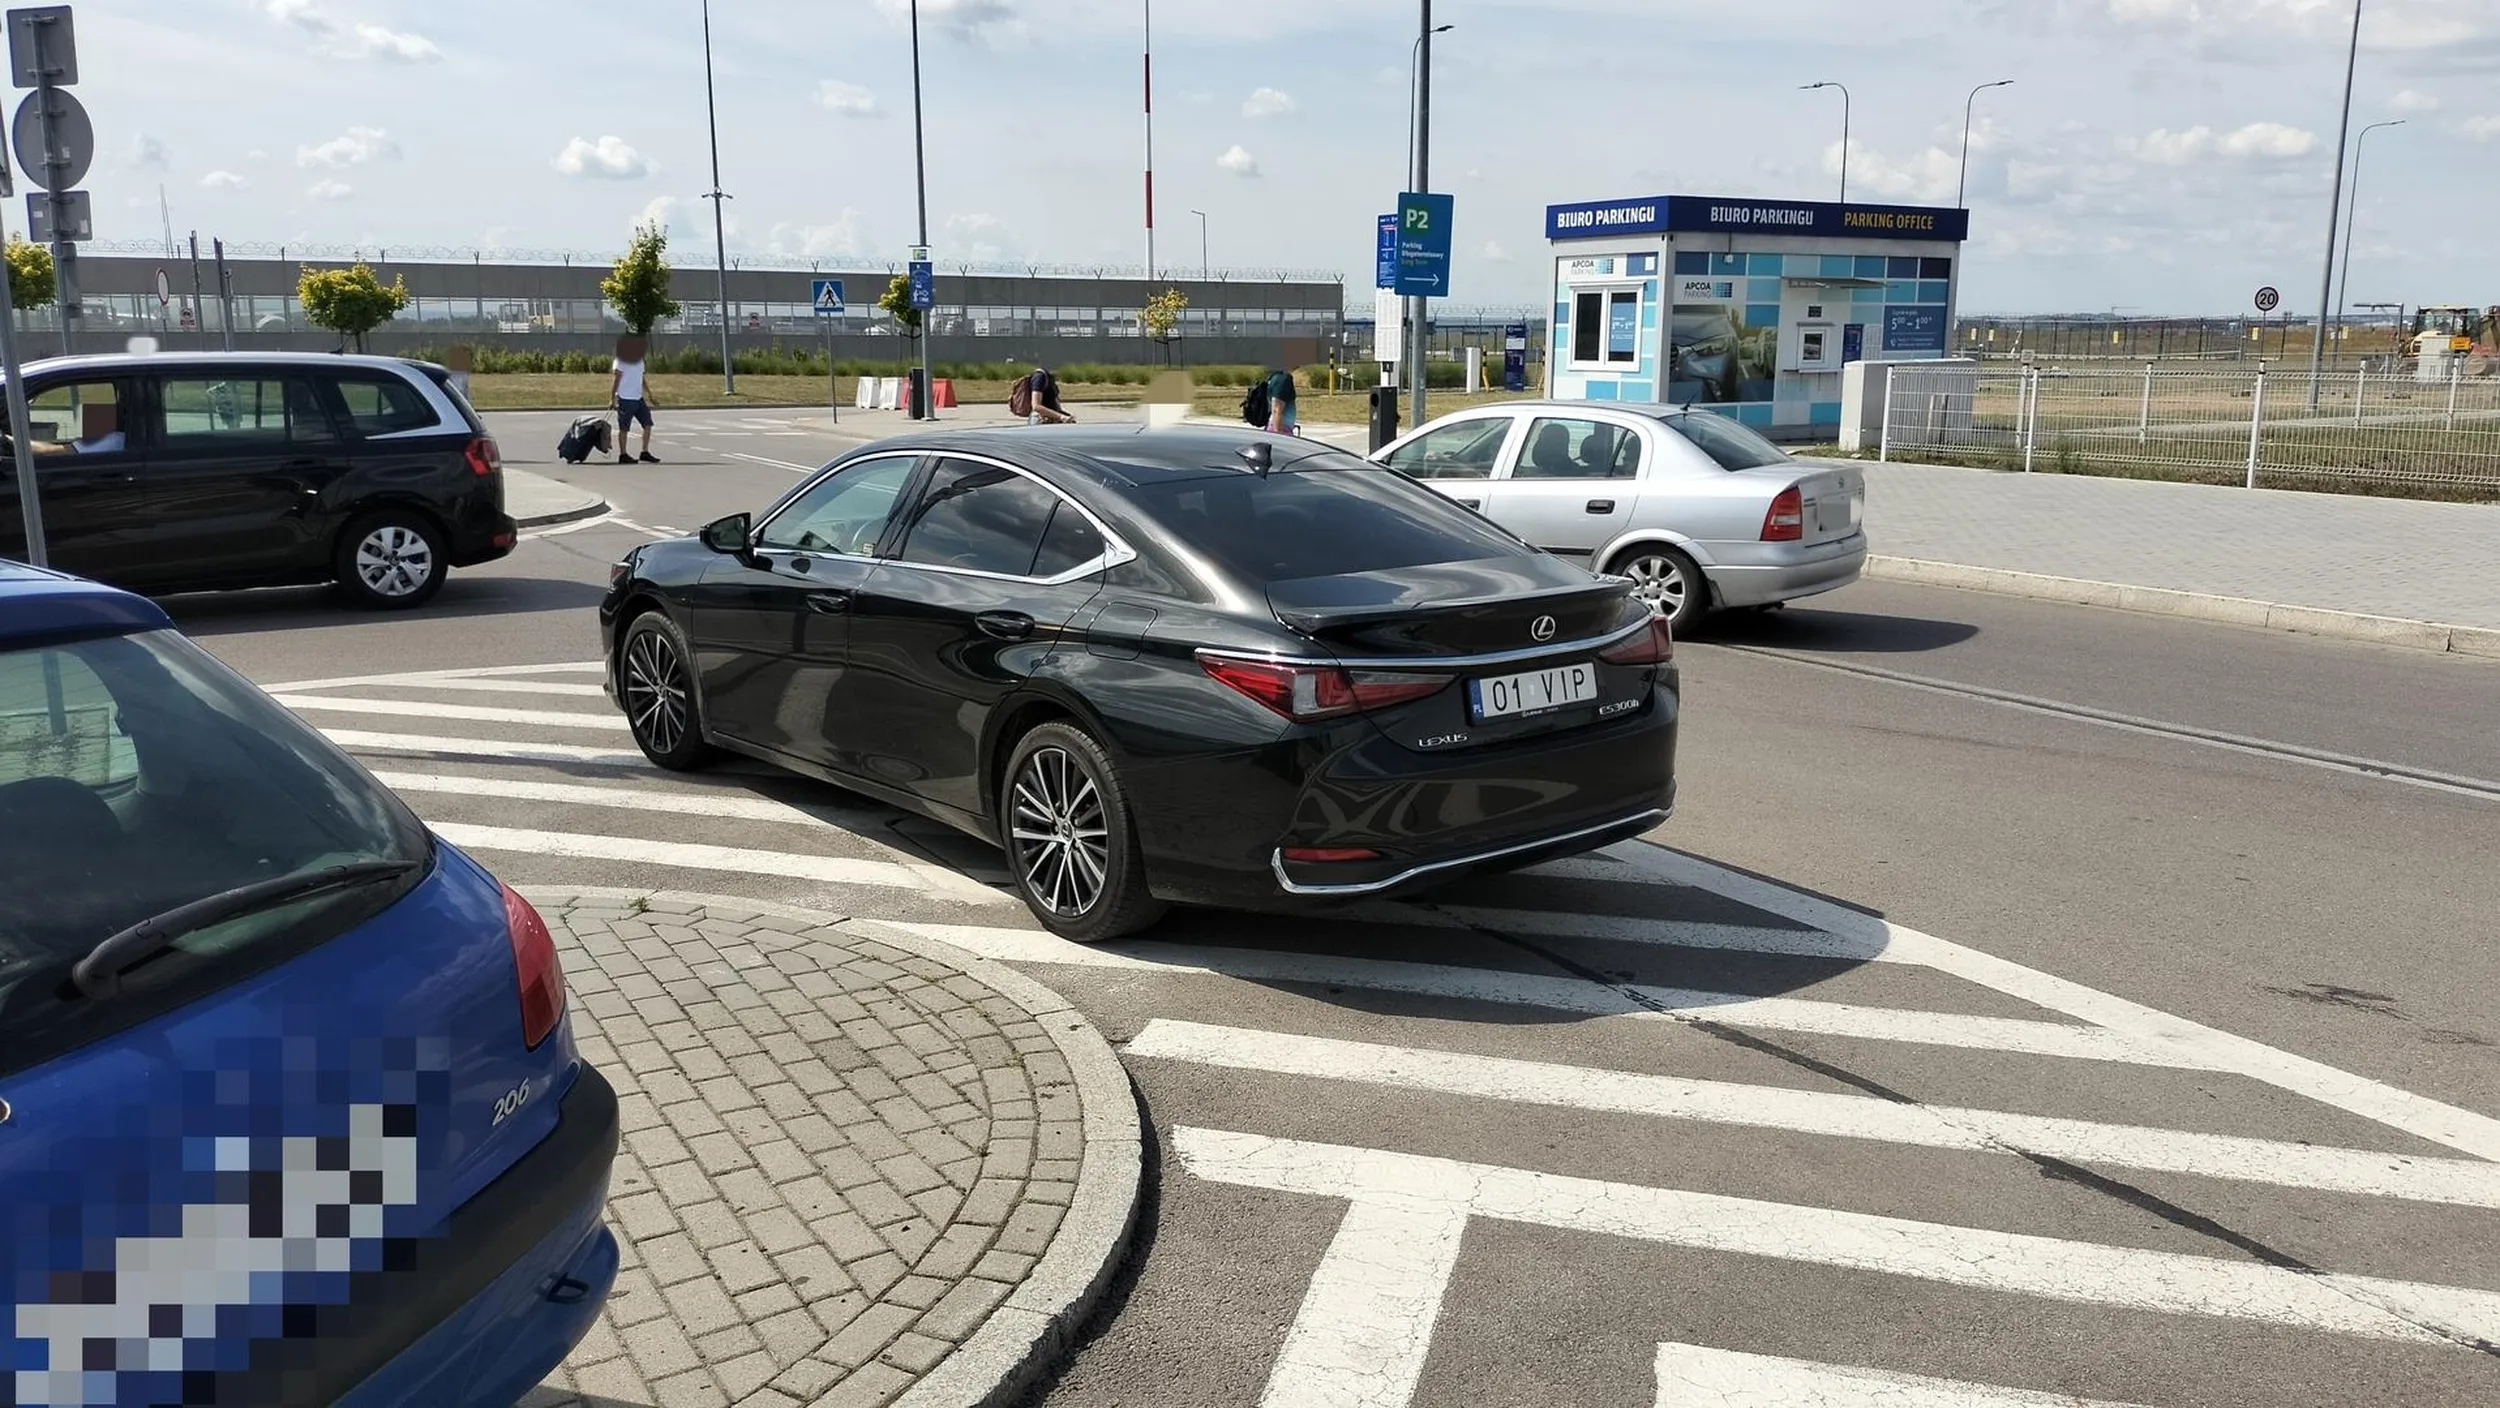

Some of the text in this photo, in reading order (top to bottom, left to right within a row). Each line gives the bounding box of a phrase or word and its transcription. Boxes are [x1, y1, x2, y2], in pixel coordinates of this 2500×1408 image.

[1405, 208, 1429, 229] P2
[1557, 206, 1656, 228] BIURO PARKINGU
[1710, 206, 1813, 226] BIURO PARKINGU
[1844, 212, 1934, 230] PARKING OFFICE
[1684, 281, 1711, 290] APCOA
[2259, 292, 2276, 305] 20
[1492, 668, 1585, 712] 01 VIP
[1418, 732, 1468, 748] LEXUS
[492, 1075, 530, 1126] 206
